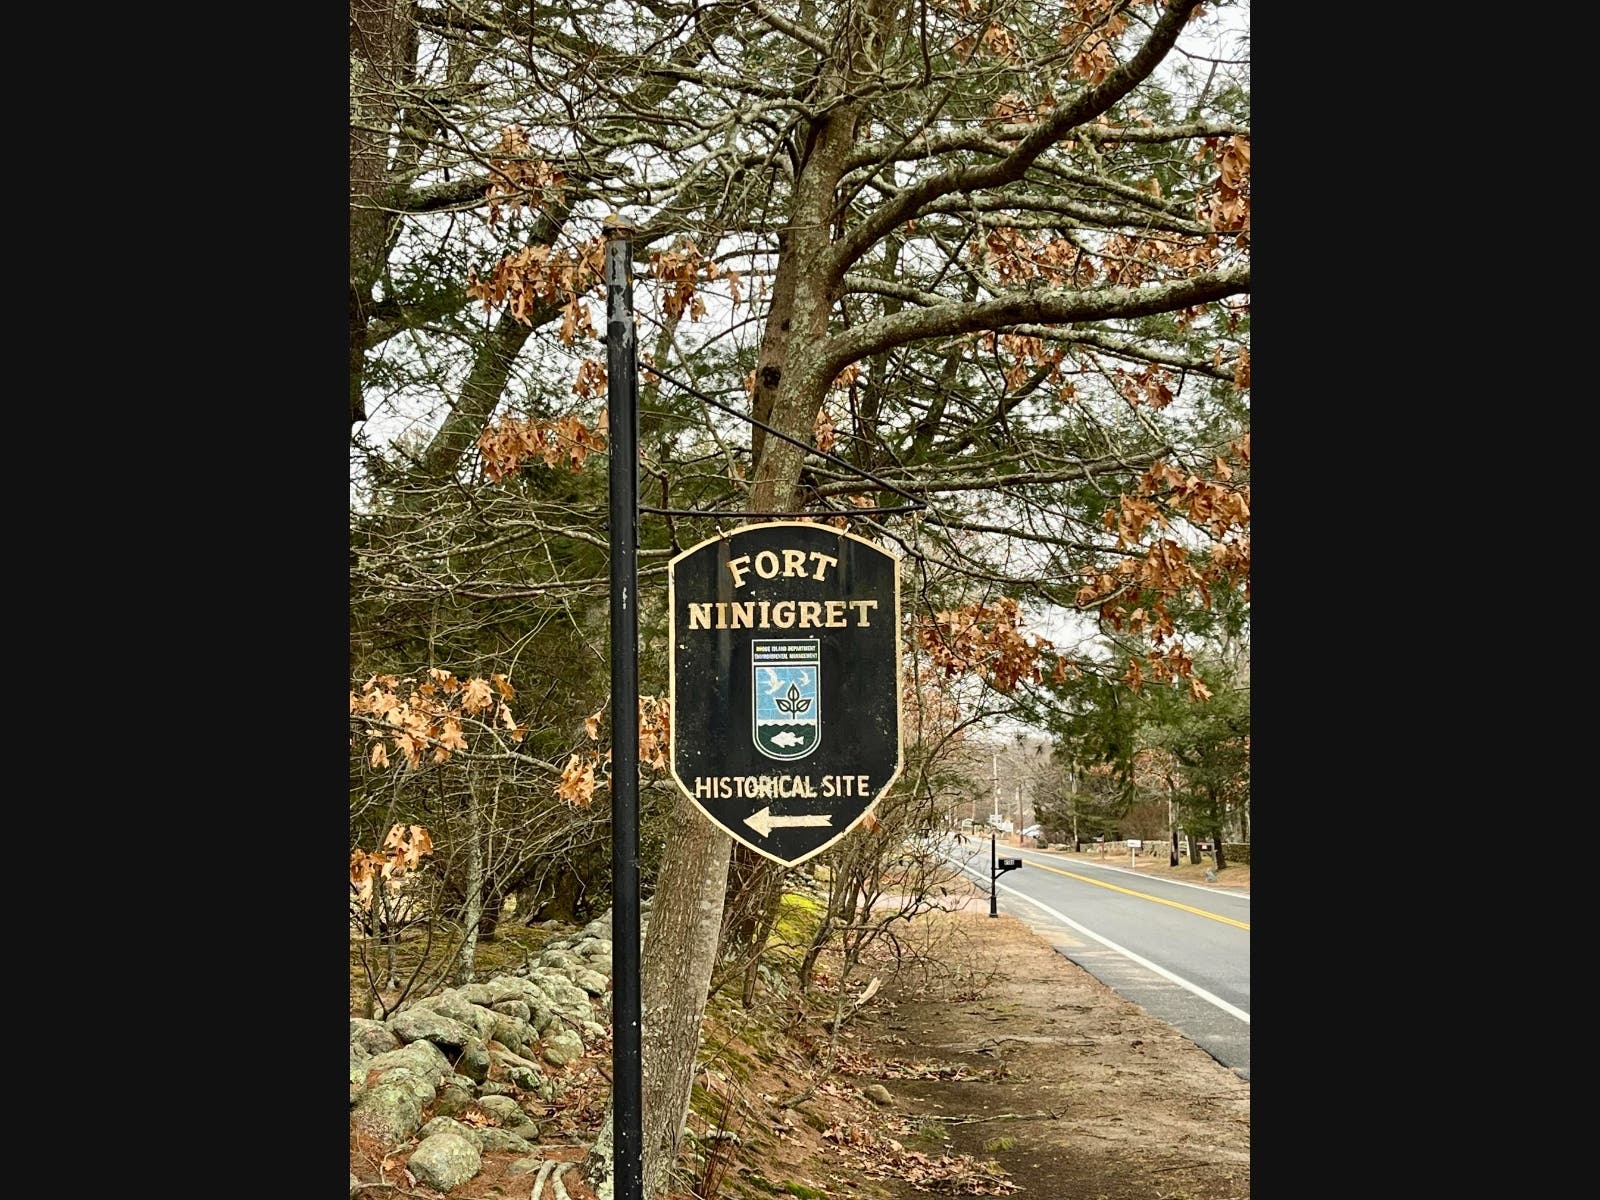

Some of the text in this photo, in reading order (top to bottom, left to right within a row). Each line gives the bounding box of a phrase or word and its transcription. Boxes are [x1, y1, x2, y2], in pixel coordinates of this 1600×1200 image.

[726, 549, 838, 588] FORT
[687, 600, 878, 630] NINIGRET
[694, 774, 870, 799] HISTORICAL SITE
